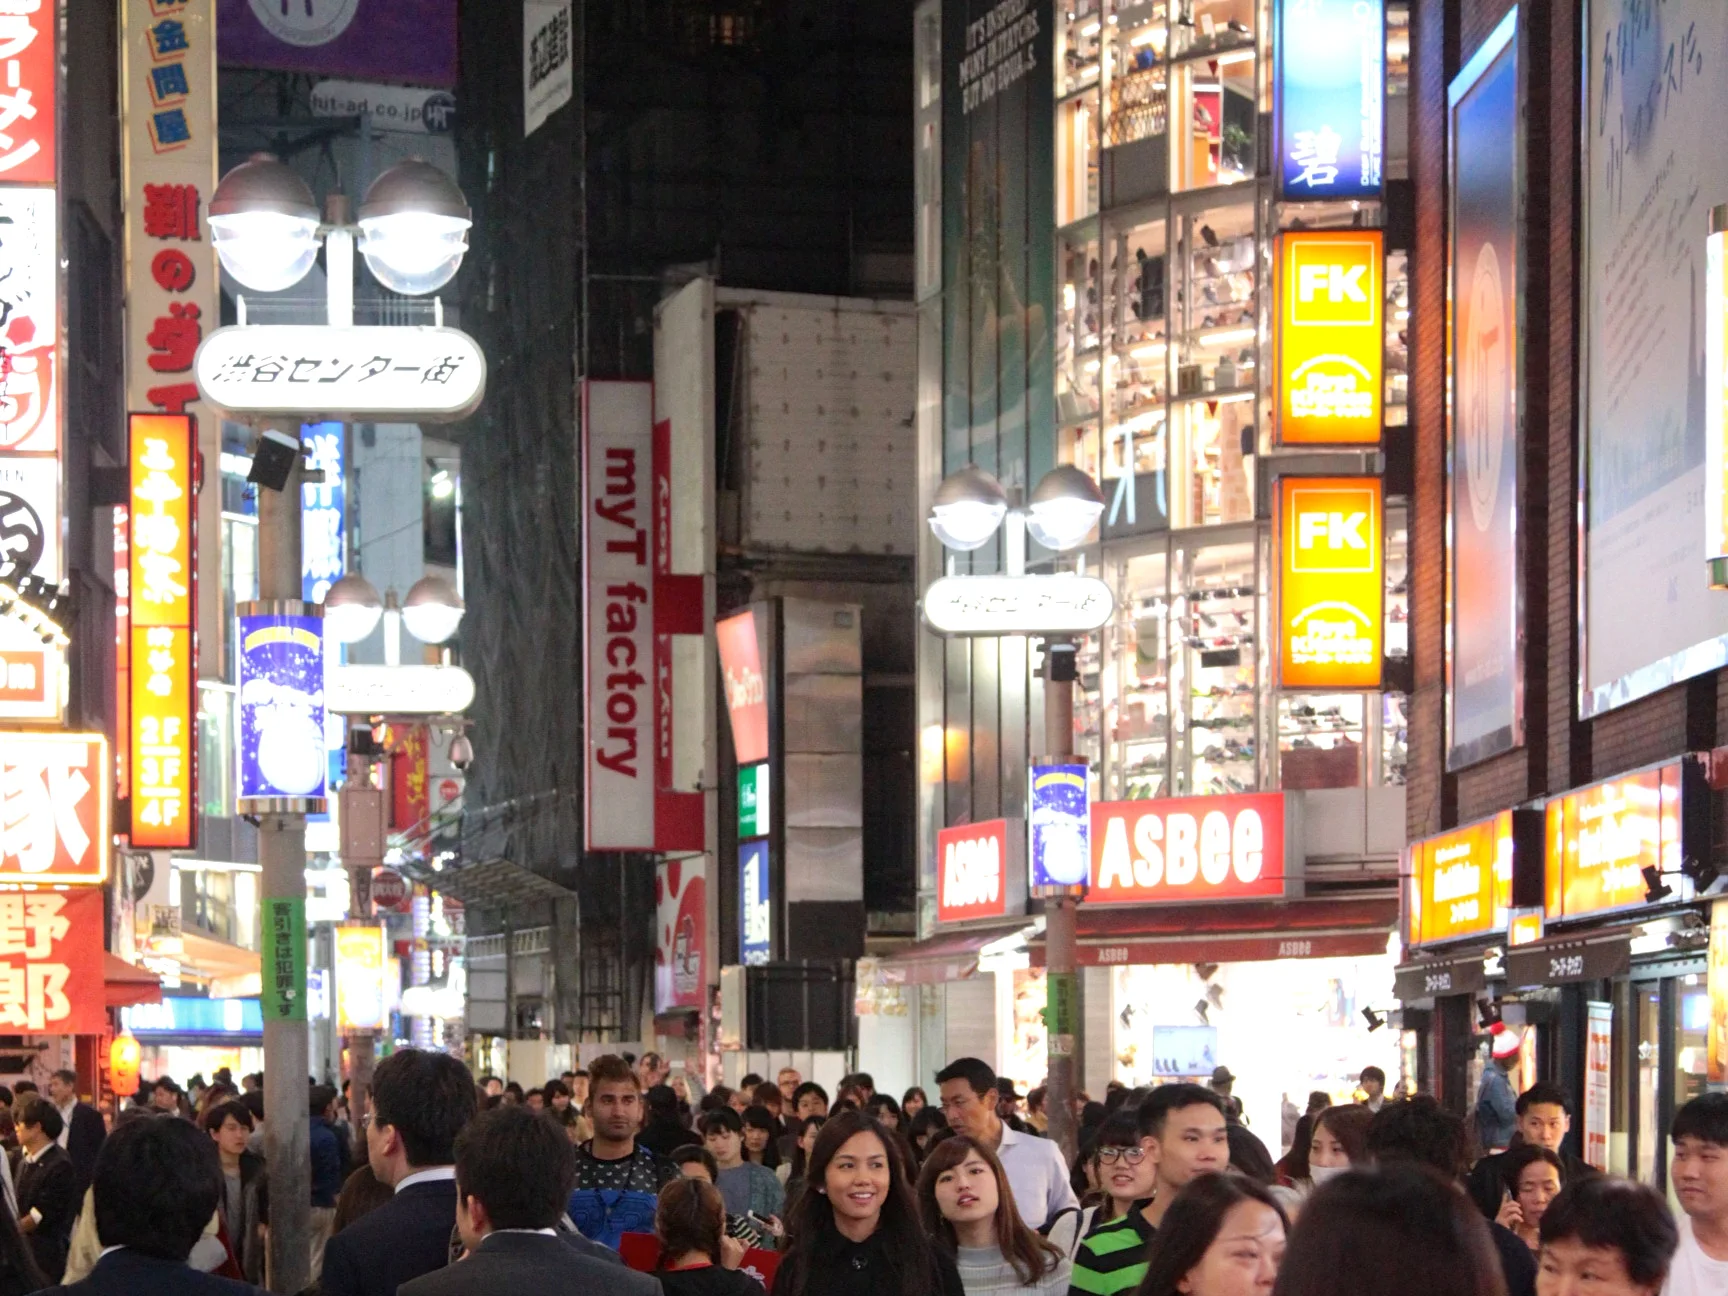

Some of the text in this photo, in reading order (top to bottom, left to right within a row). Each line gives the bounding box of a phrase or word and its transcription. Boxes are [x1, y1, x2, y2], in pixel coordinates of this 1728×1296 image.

[1299, 264, 1367, 303] FK
[212, 354, 465, 384] 渋谷センター街
[1299, 511, 1368, 550] FK
[594, 446, 647, 779] myT factory
[139, 716, 181, 745] 2F
[139, 757, 181, 786] 3F
[139, 798, 181, 827] 4F
[0, 893, 72, 1031] 野郎
